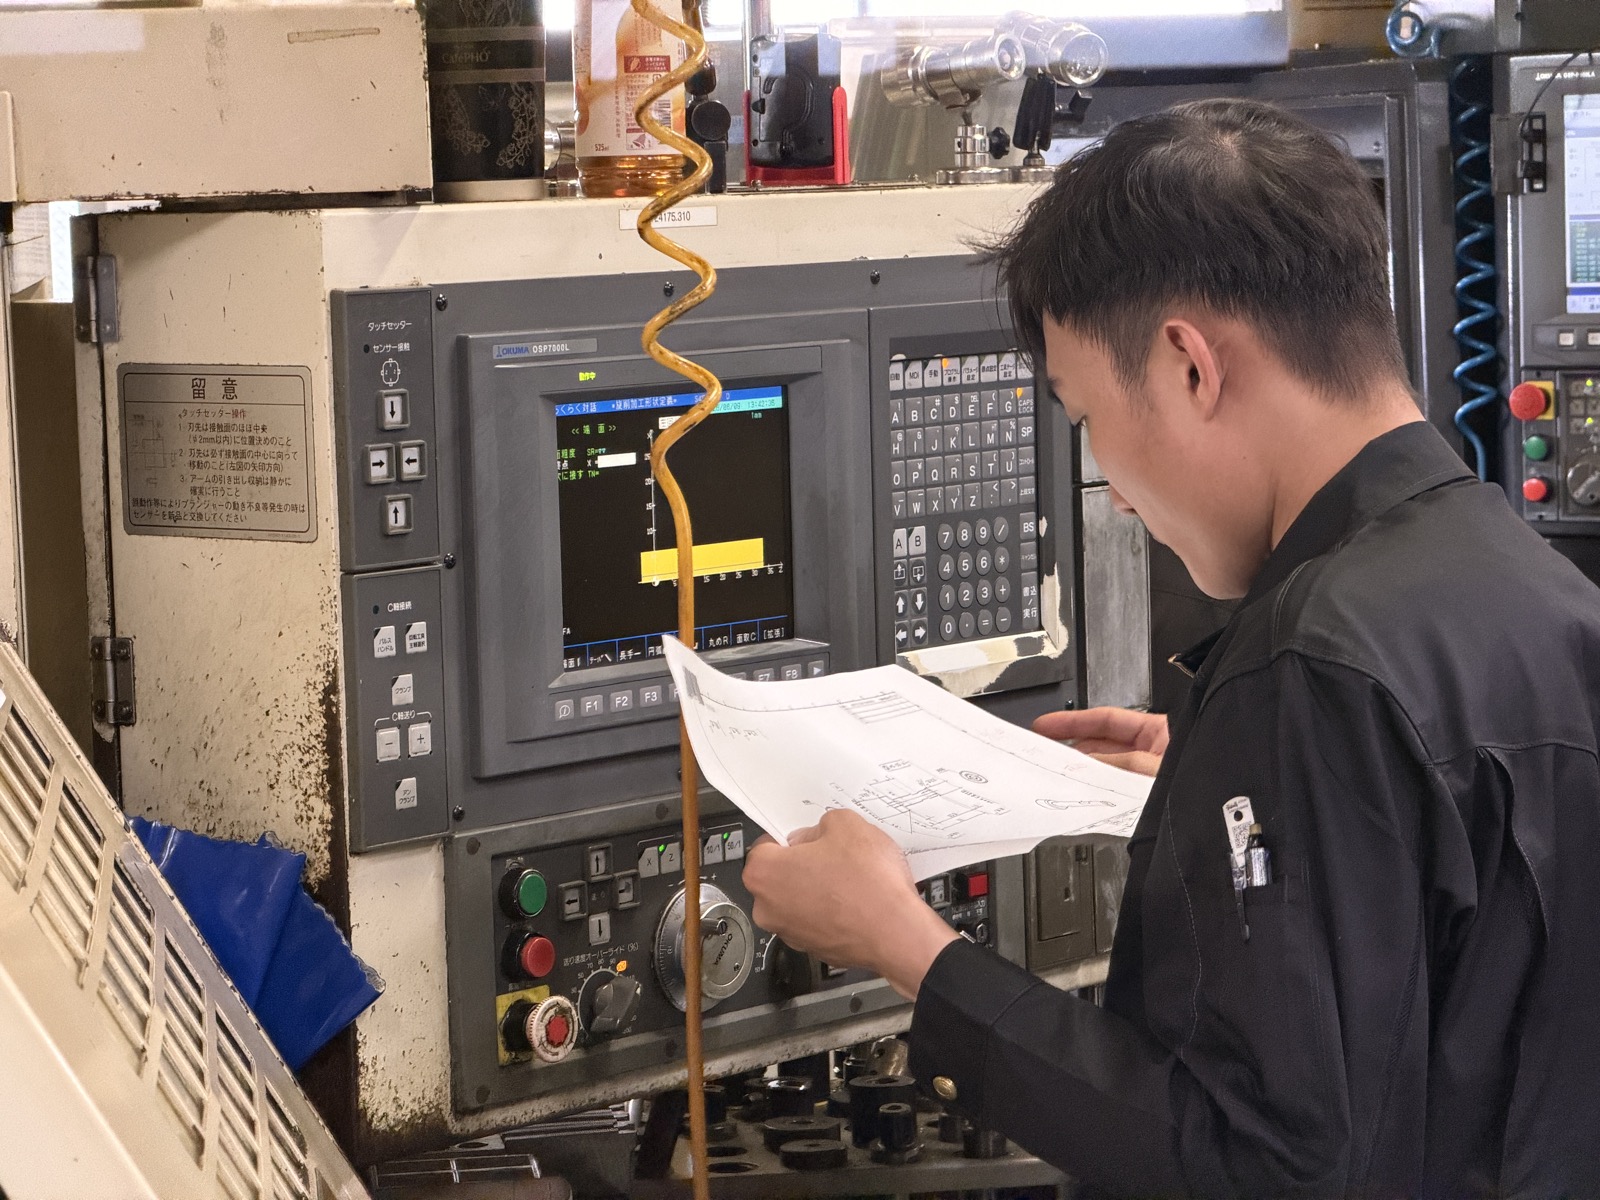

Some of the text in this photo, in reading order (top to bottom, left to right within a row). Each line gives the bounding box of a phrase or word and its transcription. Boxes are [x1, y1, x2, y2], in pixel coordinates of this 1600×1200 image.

[368, 321, 412, 331] タッチセッター
[502, 344, 570, 355] OKUMA OSP7000L
[929, 370, 938, 378] 手動
[191, 377, 238, 400] 留 意
[950, 407, 956, 418] D
[968, 405, 974, 416] E
[987, 403, 993, 414] F
[1005, 401, 1012, 413] G
[1018, 406, 1033, 414] LOCK
[892, 412, 899, 423] A
[911, 410, 918, 422] B
[930, 408, 937, 420] C
[1006, 431, 1012, 442] N
[1021, 426, 1033, 437] SP
[950, 437, 956, 448] K
[969, 436, 975, 446] L
[987, 433, 994, 445] M
[892, 443, 899, 454] H
[914, 441, 916, 452] I
[932, 439, 938, 451] J
[969, 465, 976, 477] S
[987, 464, 994, 474] T
[1006, 461, 1012, 472] U
[913, 472, 919, 483] P
[932, 469, 938, 481] Q
[951, 467, 957, 479] R
[893, 474, 900, 485] O
[932, 500, 938, 511] X
[951, 498, 958, 509] Y
[970, 496, 976, 507] Z
[894, 505, 900, 516] V
[913, 503, 920, 514] W
[980, 527, 987, 538] 9
[1023, 522, 1034, 533] BS
[943, 532, 949, 543] 7
[961, 529, 968, 541] 8
[896, 537, 902, 549] A
[915, 536, 921, 547] B
[943, 562, 950, 573] 4
[962, 560, 969, 571] 5
[981, 557, 987, 568] 6
[963, 590, 970, 601] 2
[982, 587, 988, 598] 3
[1023, 586, 1037, 597] 書込
[945, 593, 950, 603] 1
[1023, 609, 1037, 618] 実行
[946, 623, 952, 634] 0
[585, 669, 798, 713] F1 F2 F3 F7 F8
[647, 858, 652, 866] X
[669, 854, 674, 862] Z
[713, 933, 733, 966] OKUMA
